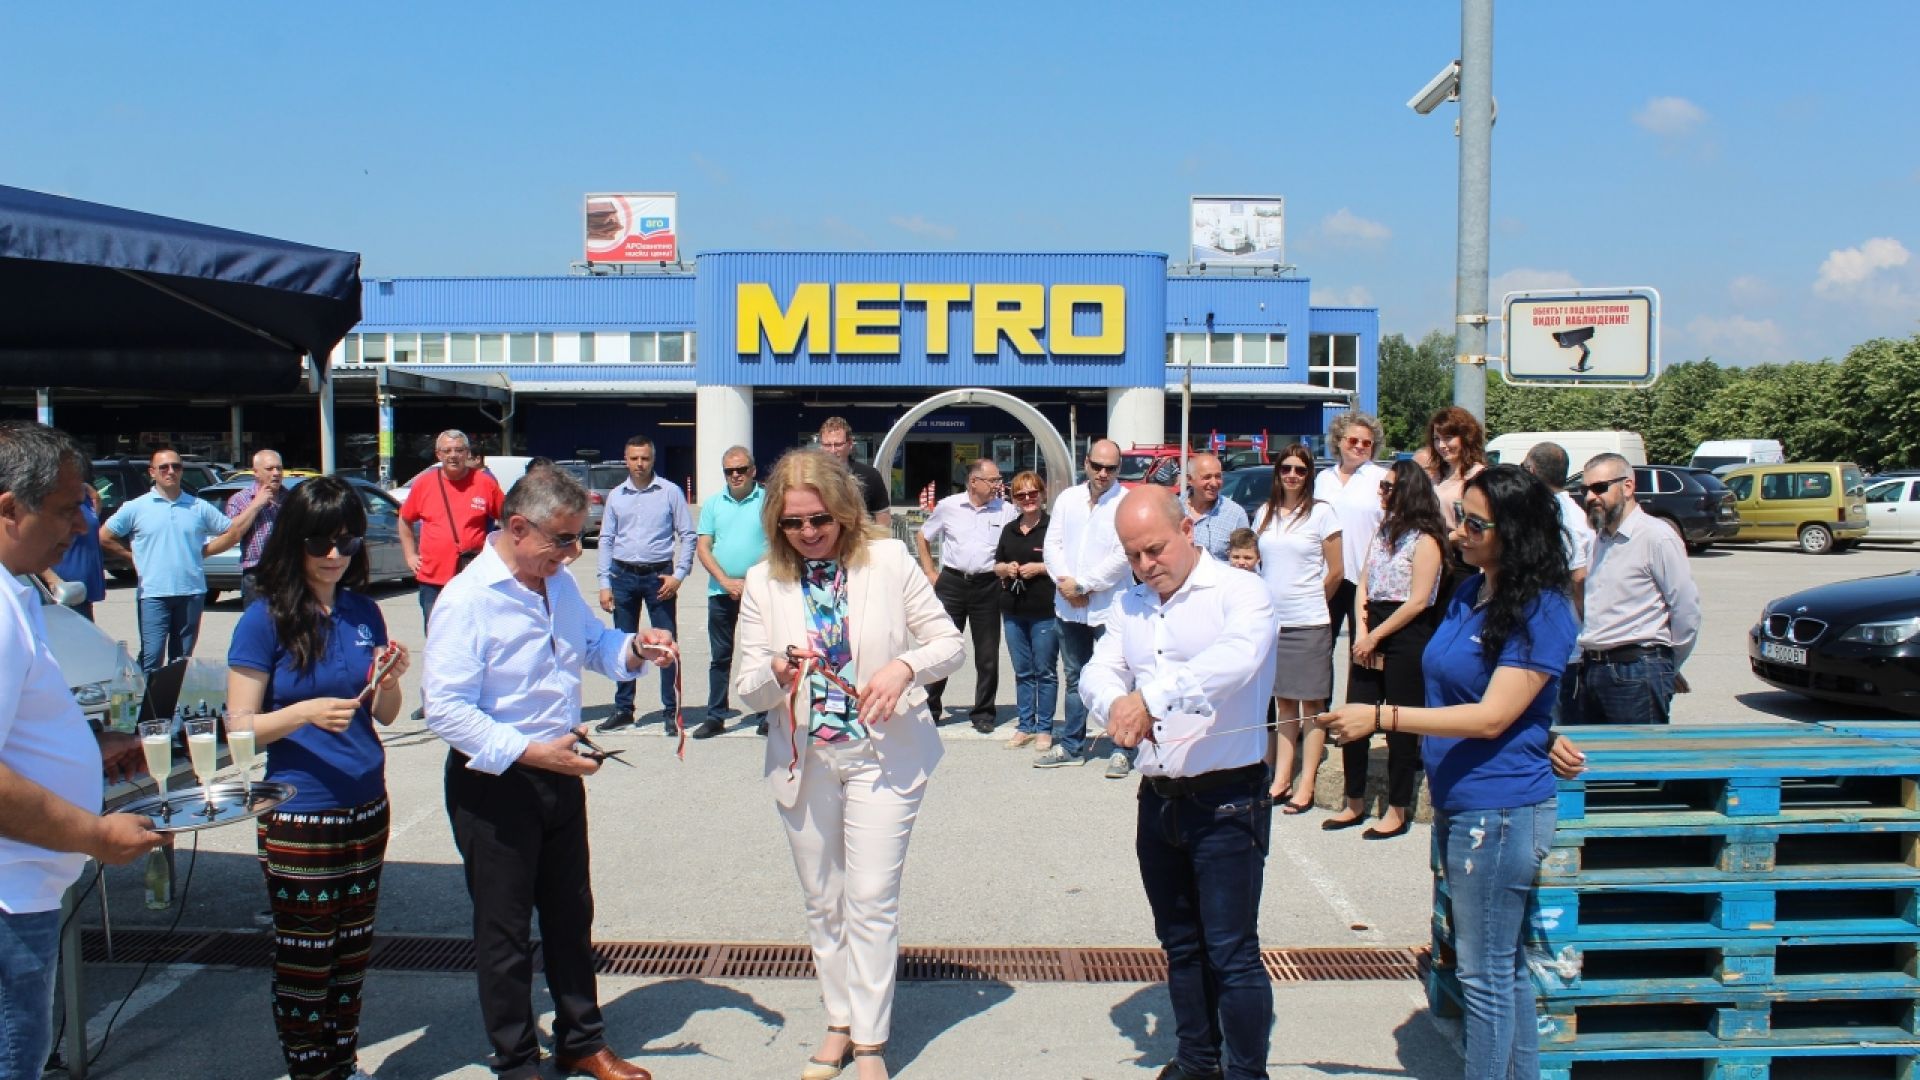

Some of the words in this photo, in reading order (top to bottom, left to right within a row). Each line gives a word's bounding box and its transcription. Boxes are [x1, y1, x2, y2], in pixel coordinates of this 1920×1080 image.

[646, 219, 664, 228] aro
[1570, 306, 1585, 315] ПОД
[737, 283, 1125, 355] METRO
[1533, 316, 1560, 326] ВИДЕО
[1565, 315, 1629, 326] НАБЛЮДЕНИЕ!
